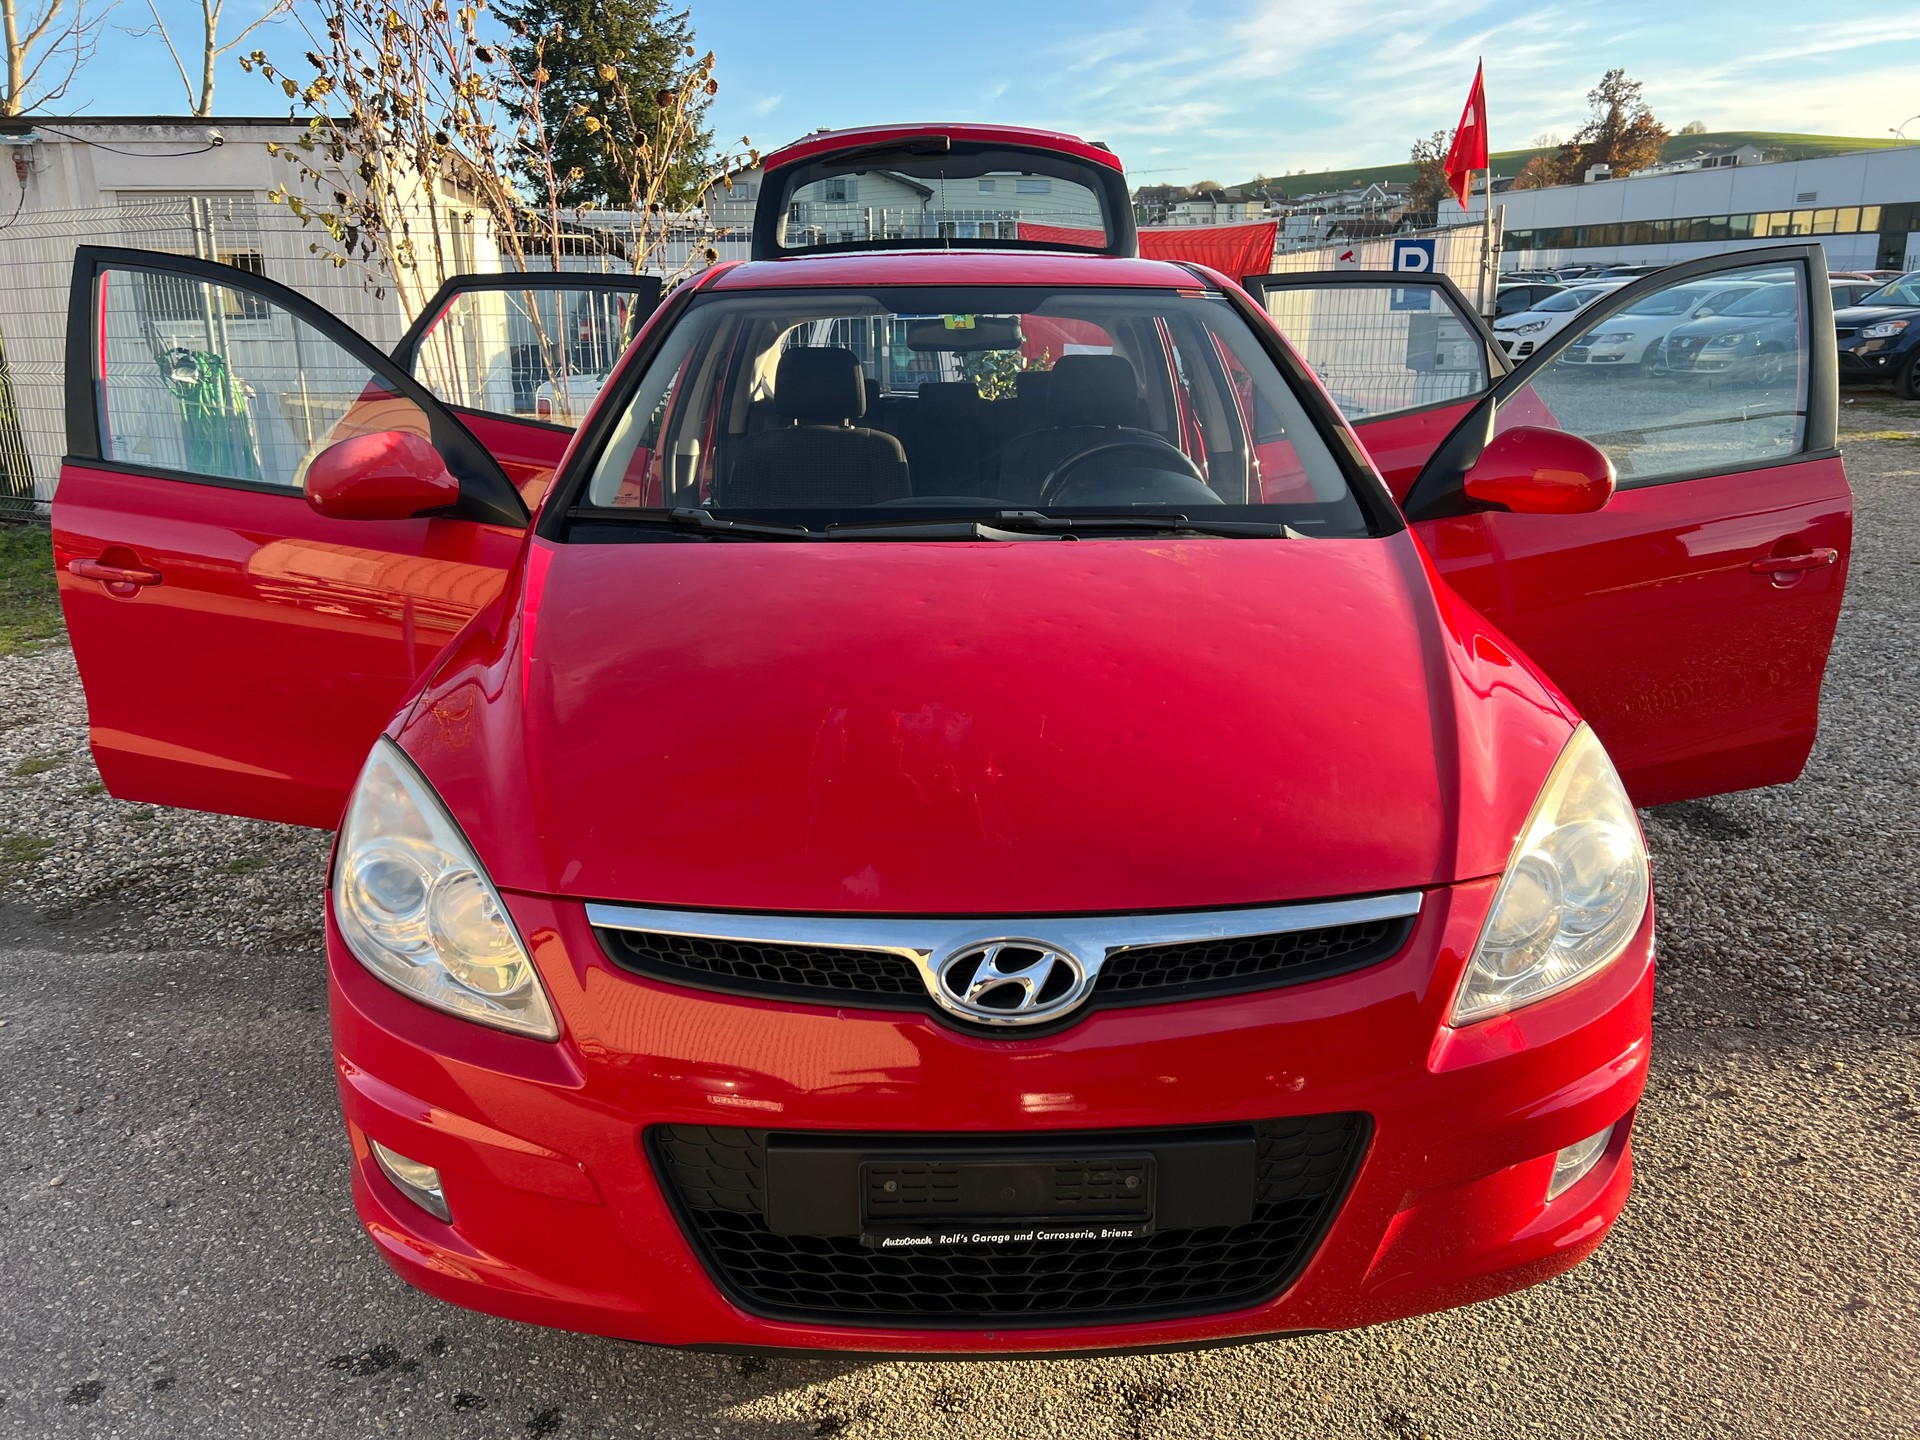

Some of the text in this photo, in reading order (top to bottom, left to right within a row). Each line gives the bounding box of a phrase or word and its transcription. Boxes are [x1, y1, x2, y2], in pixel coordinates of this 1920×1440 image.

[1396, 247, 1429, 303] P
[882, 1229, 1133, 1247] AutoCoach Rolf's Garage und Carrosserie, Brienz
